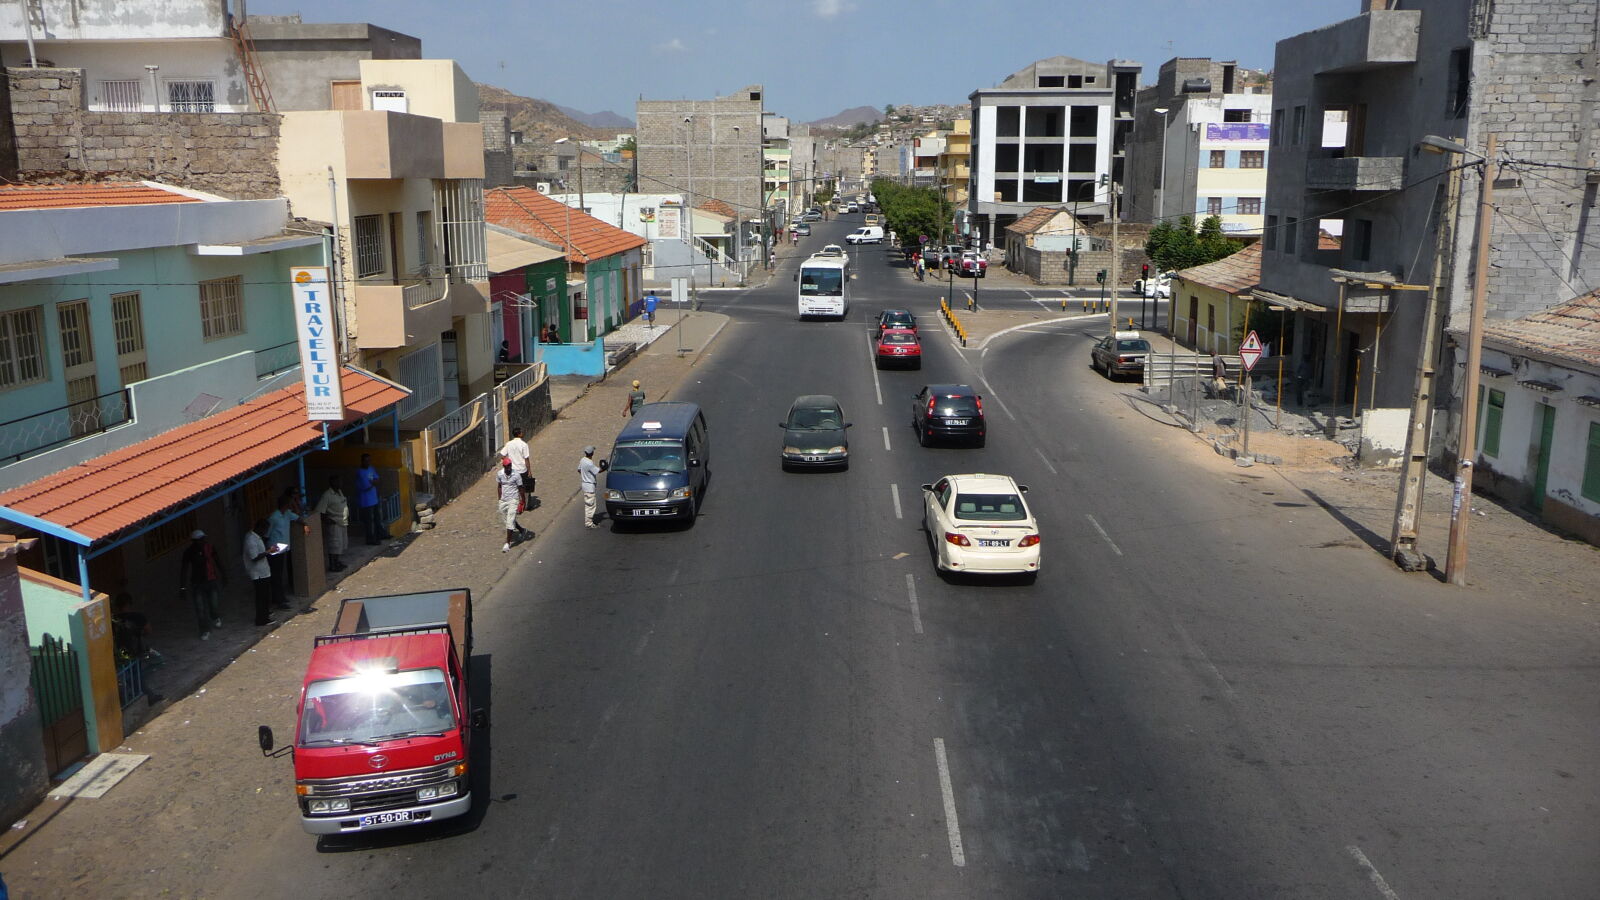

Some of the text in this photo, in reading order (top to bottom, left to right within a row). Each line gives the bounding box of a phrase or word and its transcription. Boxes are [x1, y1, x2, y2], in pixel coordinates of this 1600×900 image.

[304, 291, 331, 397] TRAVELTUR
[434, 751, 457, 761] DYNA
[347, 776, 413, 792] TOYOTA
